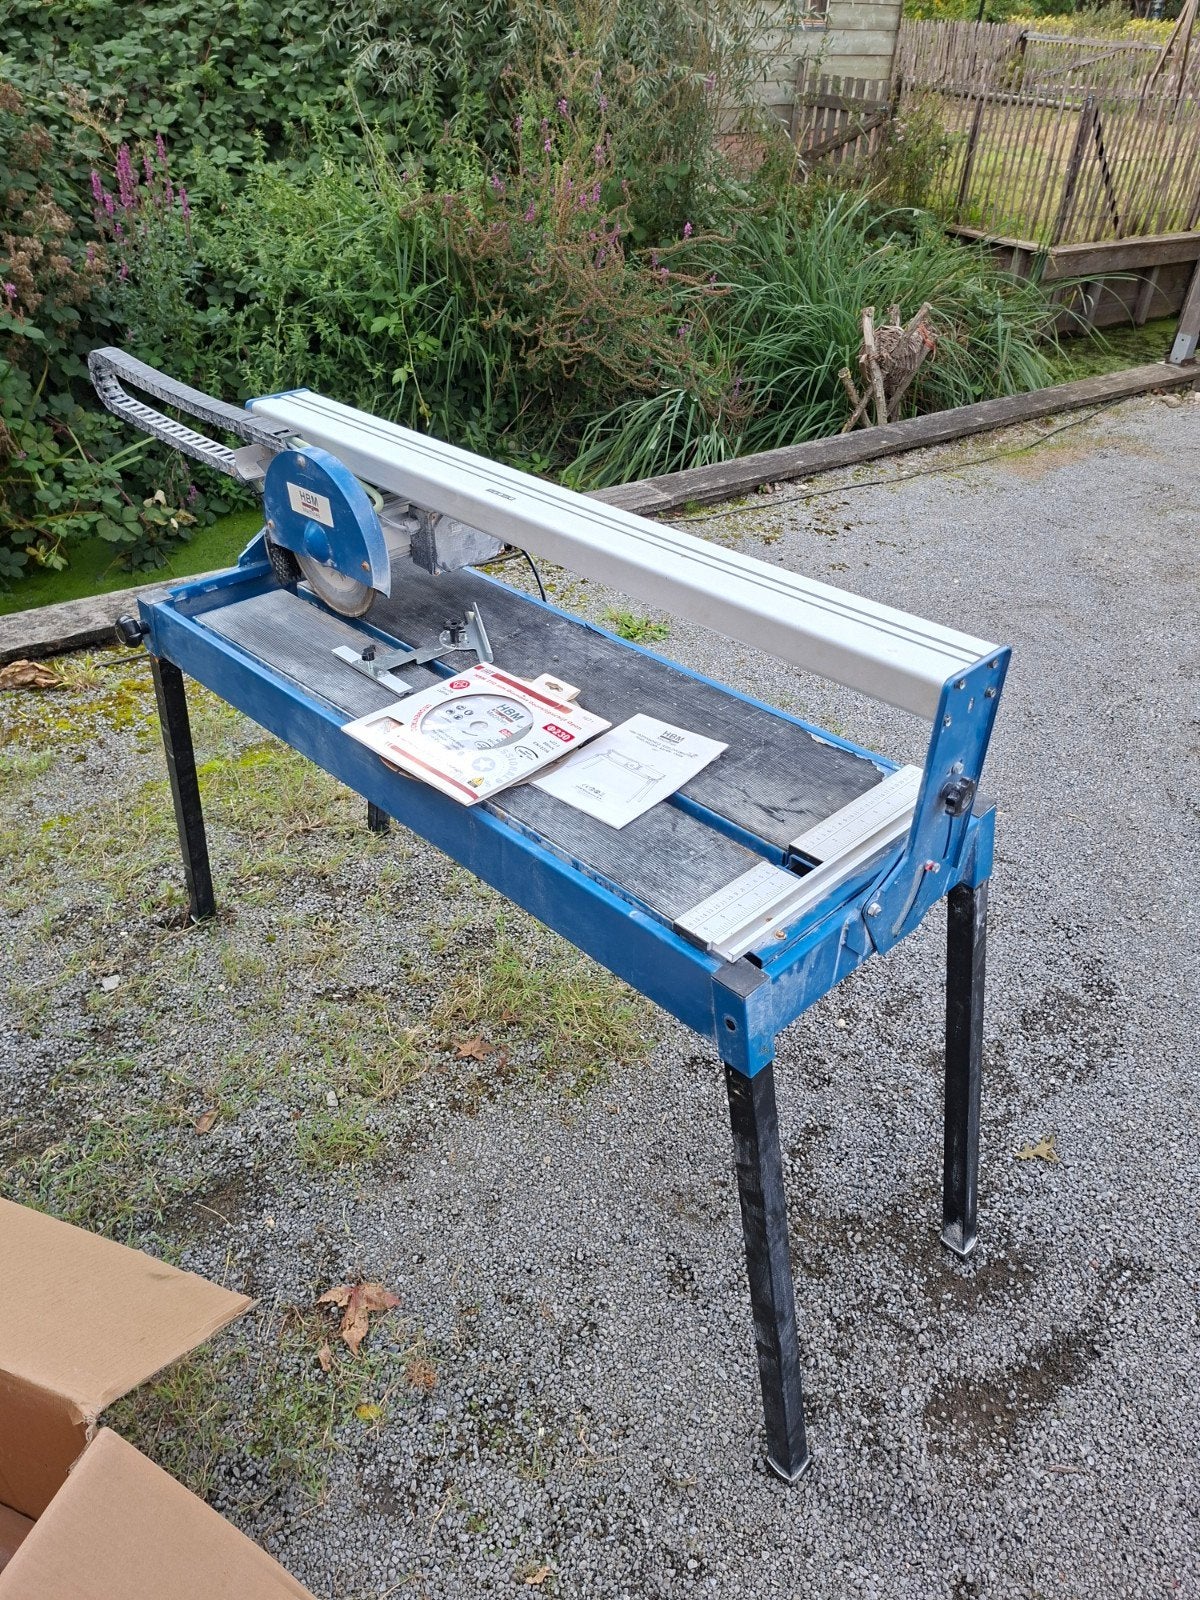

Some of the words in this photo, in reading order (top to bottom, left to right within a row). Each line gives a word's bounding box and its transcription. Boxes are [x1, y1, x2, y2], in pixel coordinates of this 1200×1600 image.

[299, 490, 319, 507] HBM
[496, 703, 525, 722] HBM
[662, 730, 685, 743] HBM
